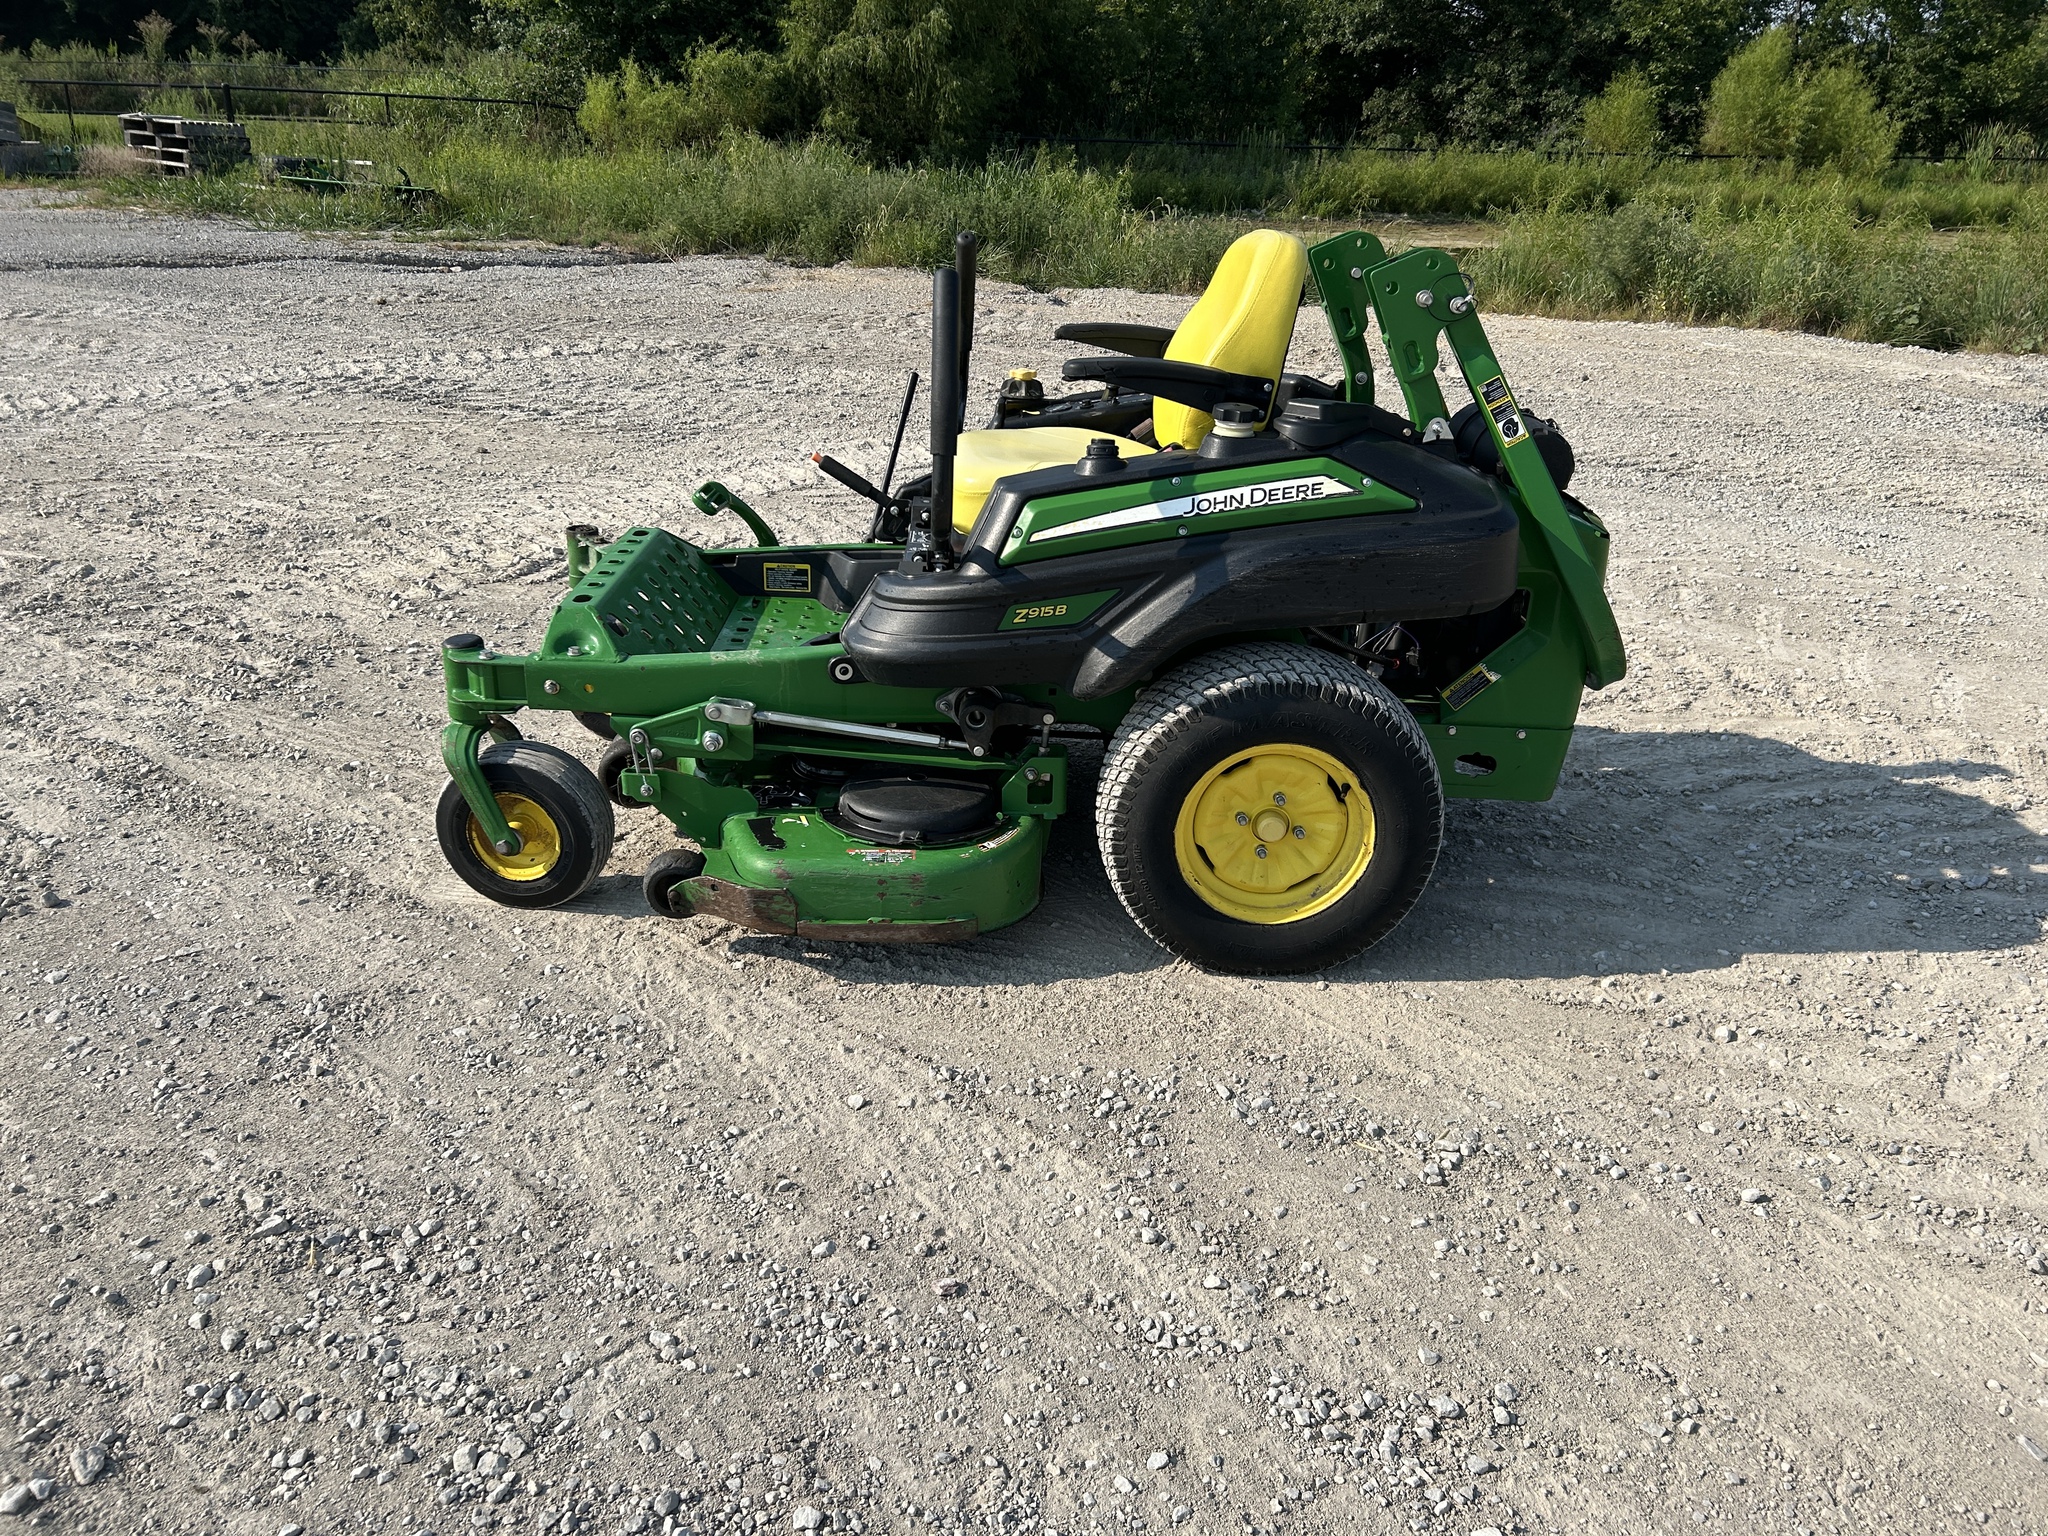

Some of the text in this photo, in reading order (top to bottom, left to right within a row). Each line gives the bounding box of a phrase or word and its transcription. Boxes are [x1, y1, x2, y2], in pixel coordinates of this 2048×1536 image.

[1183, 482, 1324, 516] JOHN DEERE
[1012, 604, 1068, 624] Z915B
[1154, 711, 1380, 791] TURF MASTER
